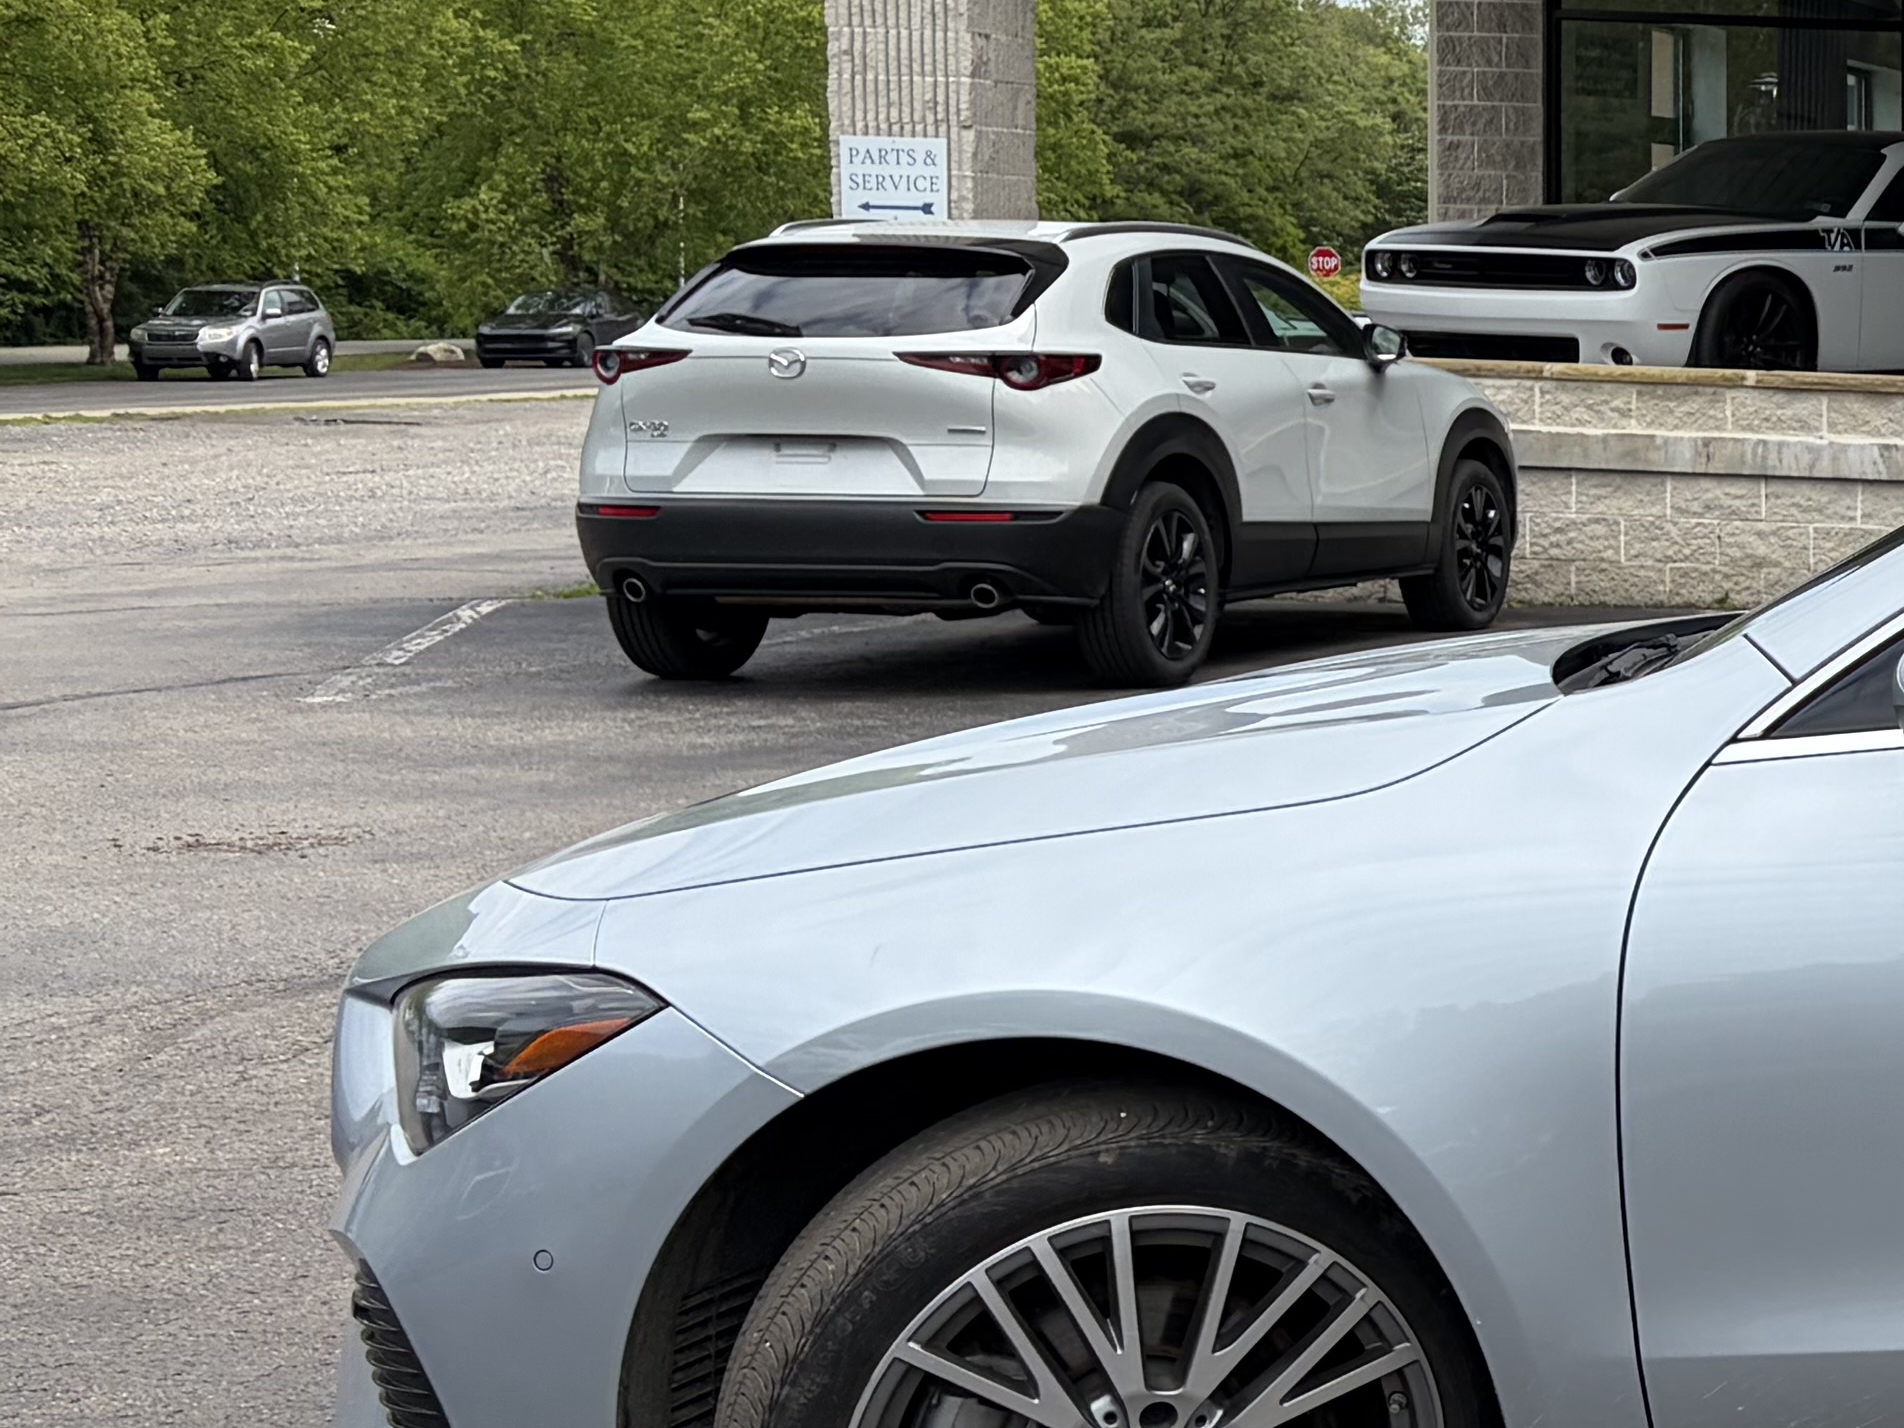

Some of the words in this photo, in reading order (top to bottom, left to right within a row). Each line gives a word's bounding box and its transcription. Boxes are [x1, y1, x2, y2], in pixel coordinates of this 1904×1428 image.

[848, 147, 917, 166] PARTS
[923, 150, 937, 166] &
[849, 173, 940, 193] SERVICE
